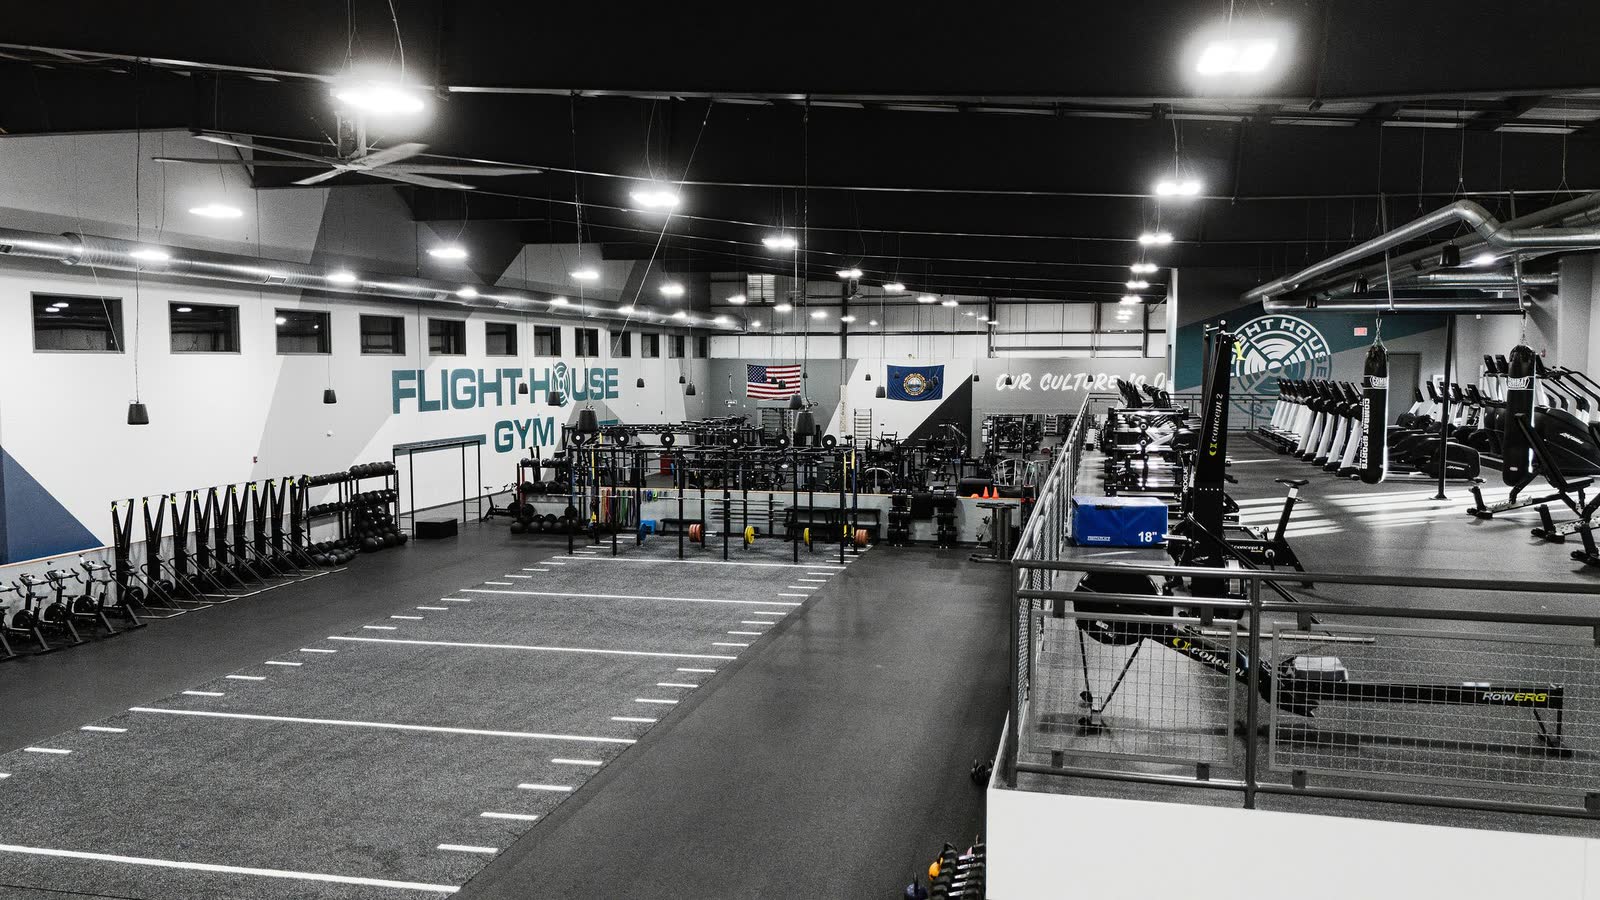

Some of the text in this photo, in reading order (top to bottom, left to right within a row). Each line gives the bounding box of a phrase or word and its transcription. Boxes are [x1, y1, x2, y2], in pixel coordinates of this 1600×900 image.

[1280, 319, 1328, 378] HOUSE
[392, 368, 522, 415] FLIGHT
[995, 372, 1166, 391] OUR CULTURE IS O
[494, 416, 555, 454] GYM
[1211, 401, 1222, 442] concept
[1361, 435, 1369, 470] SPORTS
[1138, 531, 1158, 543] 18"
